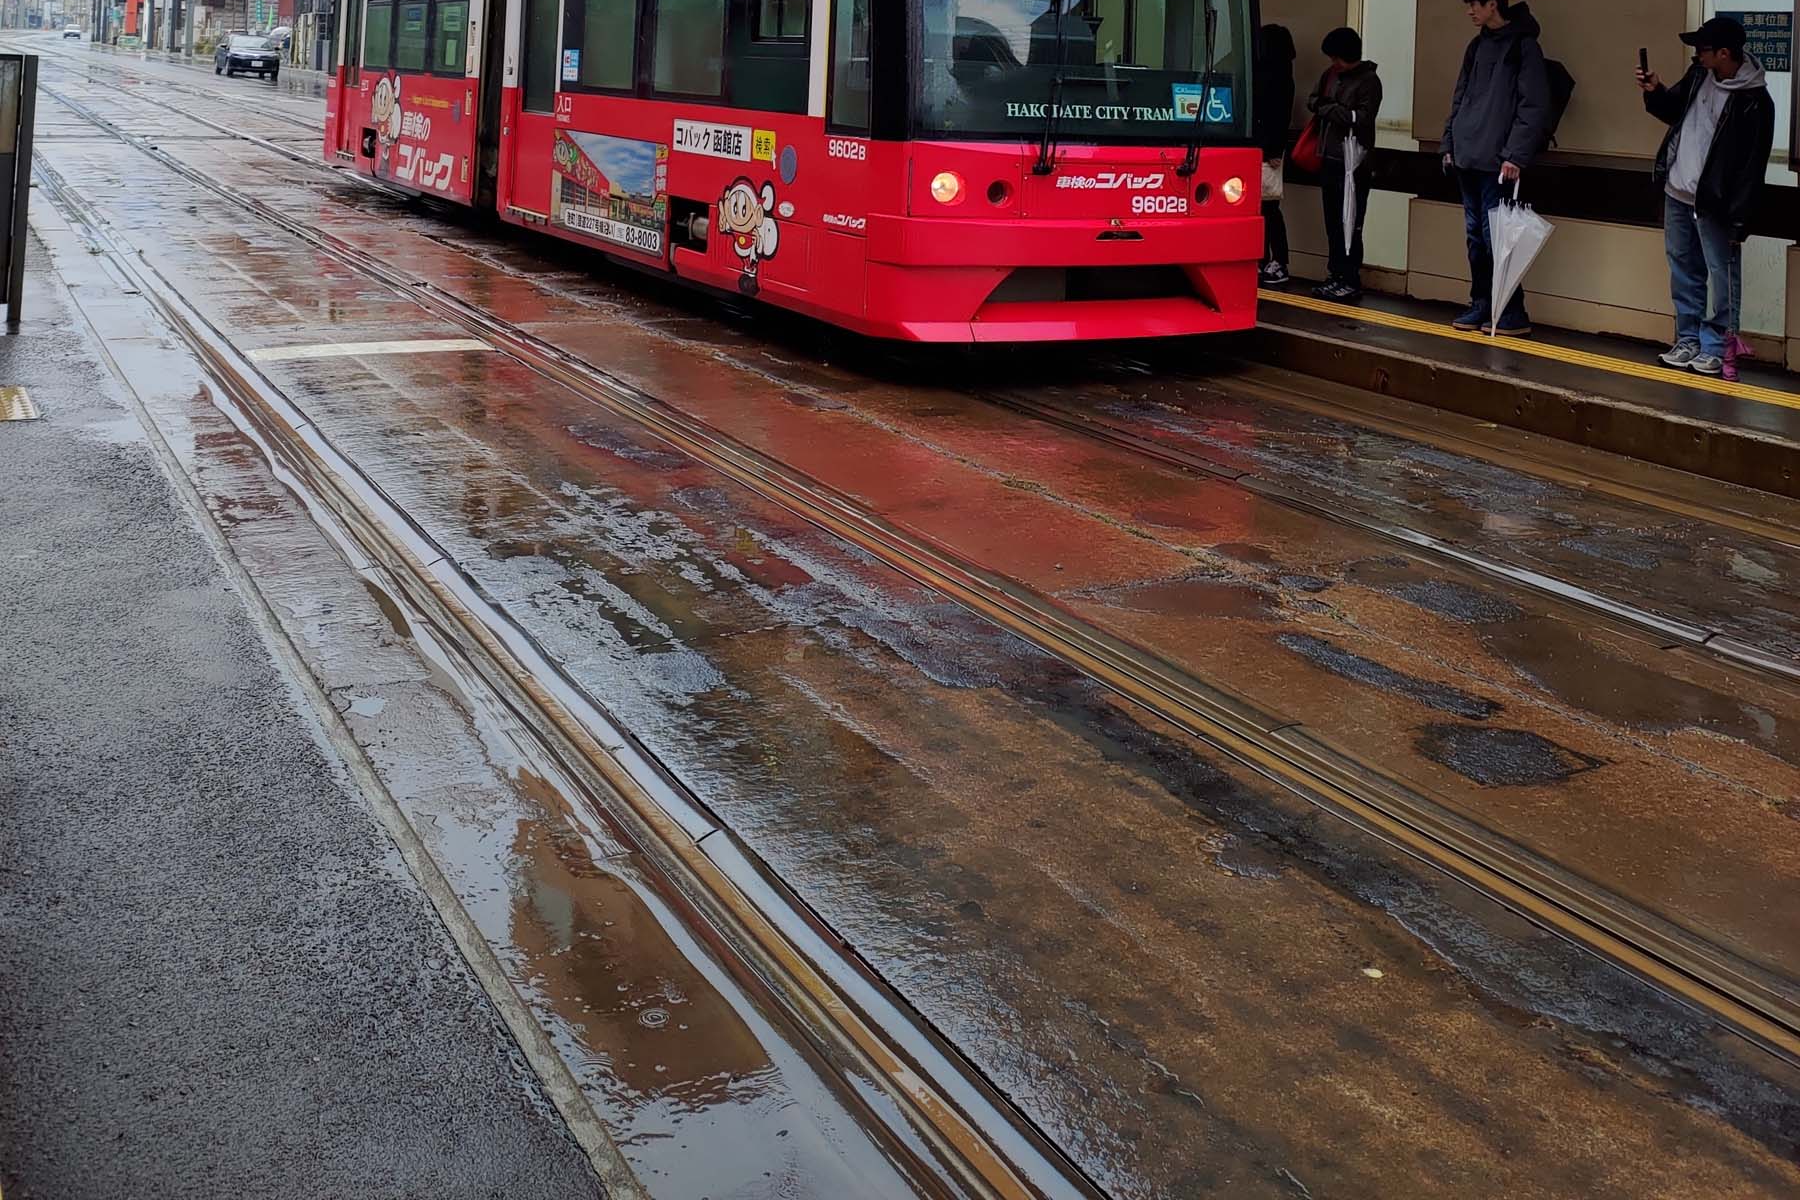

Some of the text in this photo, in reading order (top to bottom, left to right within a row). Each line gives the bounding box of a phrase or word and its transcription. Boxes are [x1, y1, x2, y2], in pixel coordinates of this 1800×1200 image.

[1765, 57, 1788, 70] 위치
[556, 95, 572, 113] 入口
[1006, 103, 1174, 121] HAKODATE CITY TRAM
[401, 111, 431, 142] 車検の
[828, 139, 866, 160] 9602B
[395, 143, 454, 191] コバック
[1131, 196, 1187, 213] 9602B
[625, 226, 658, 250] 83-8003
